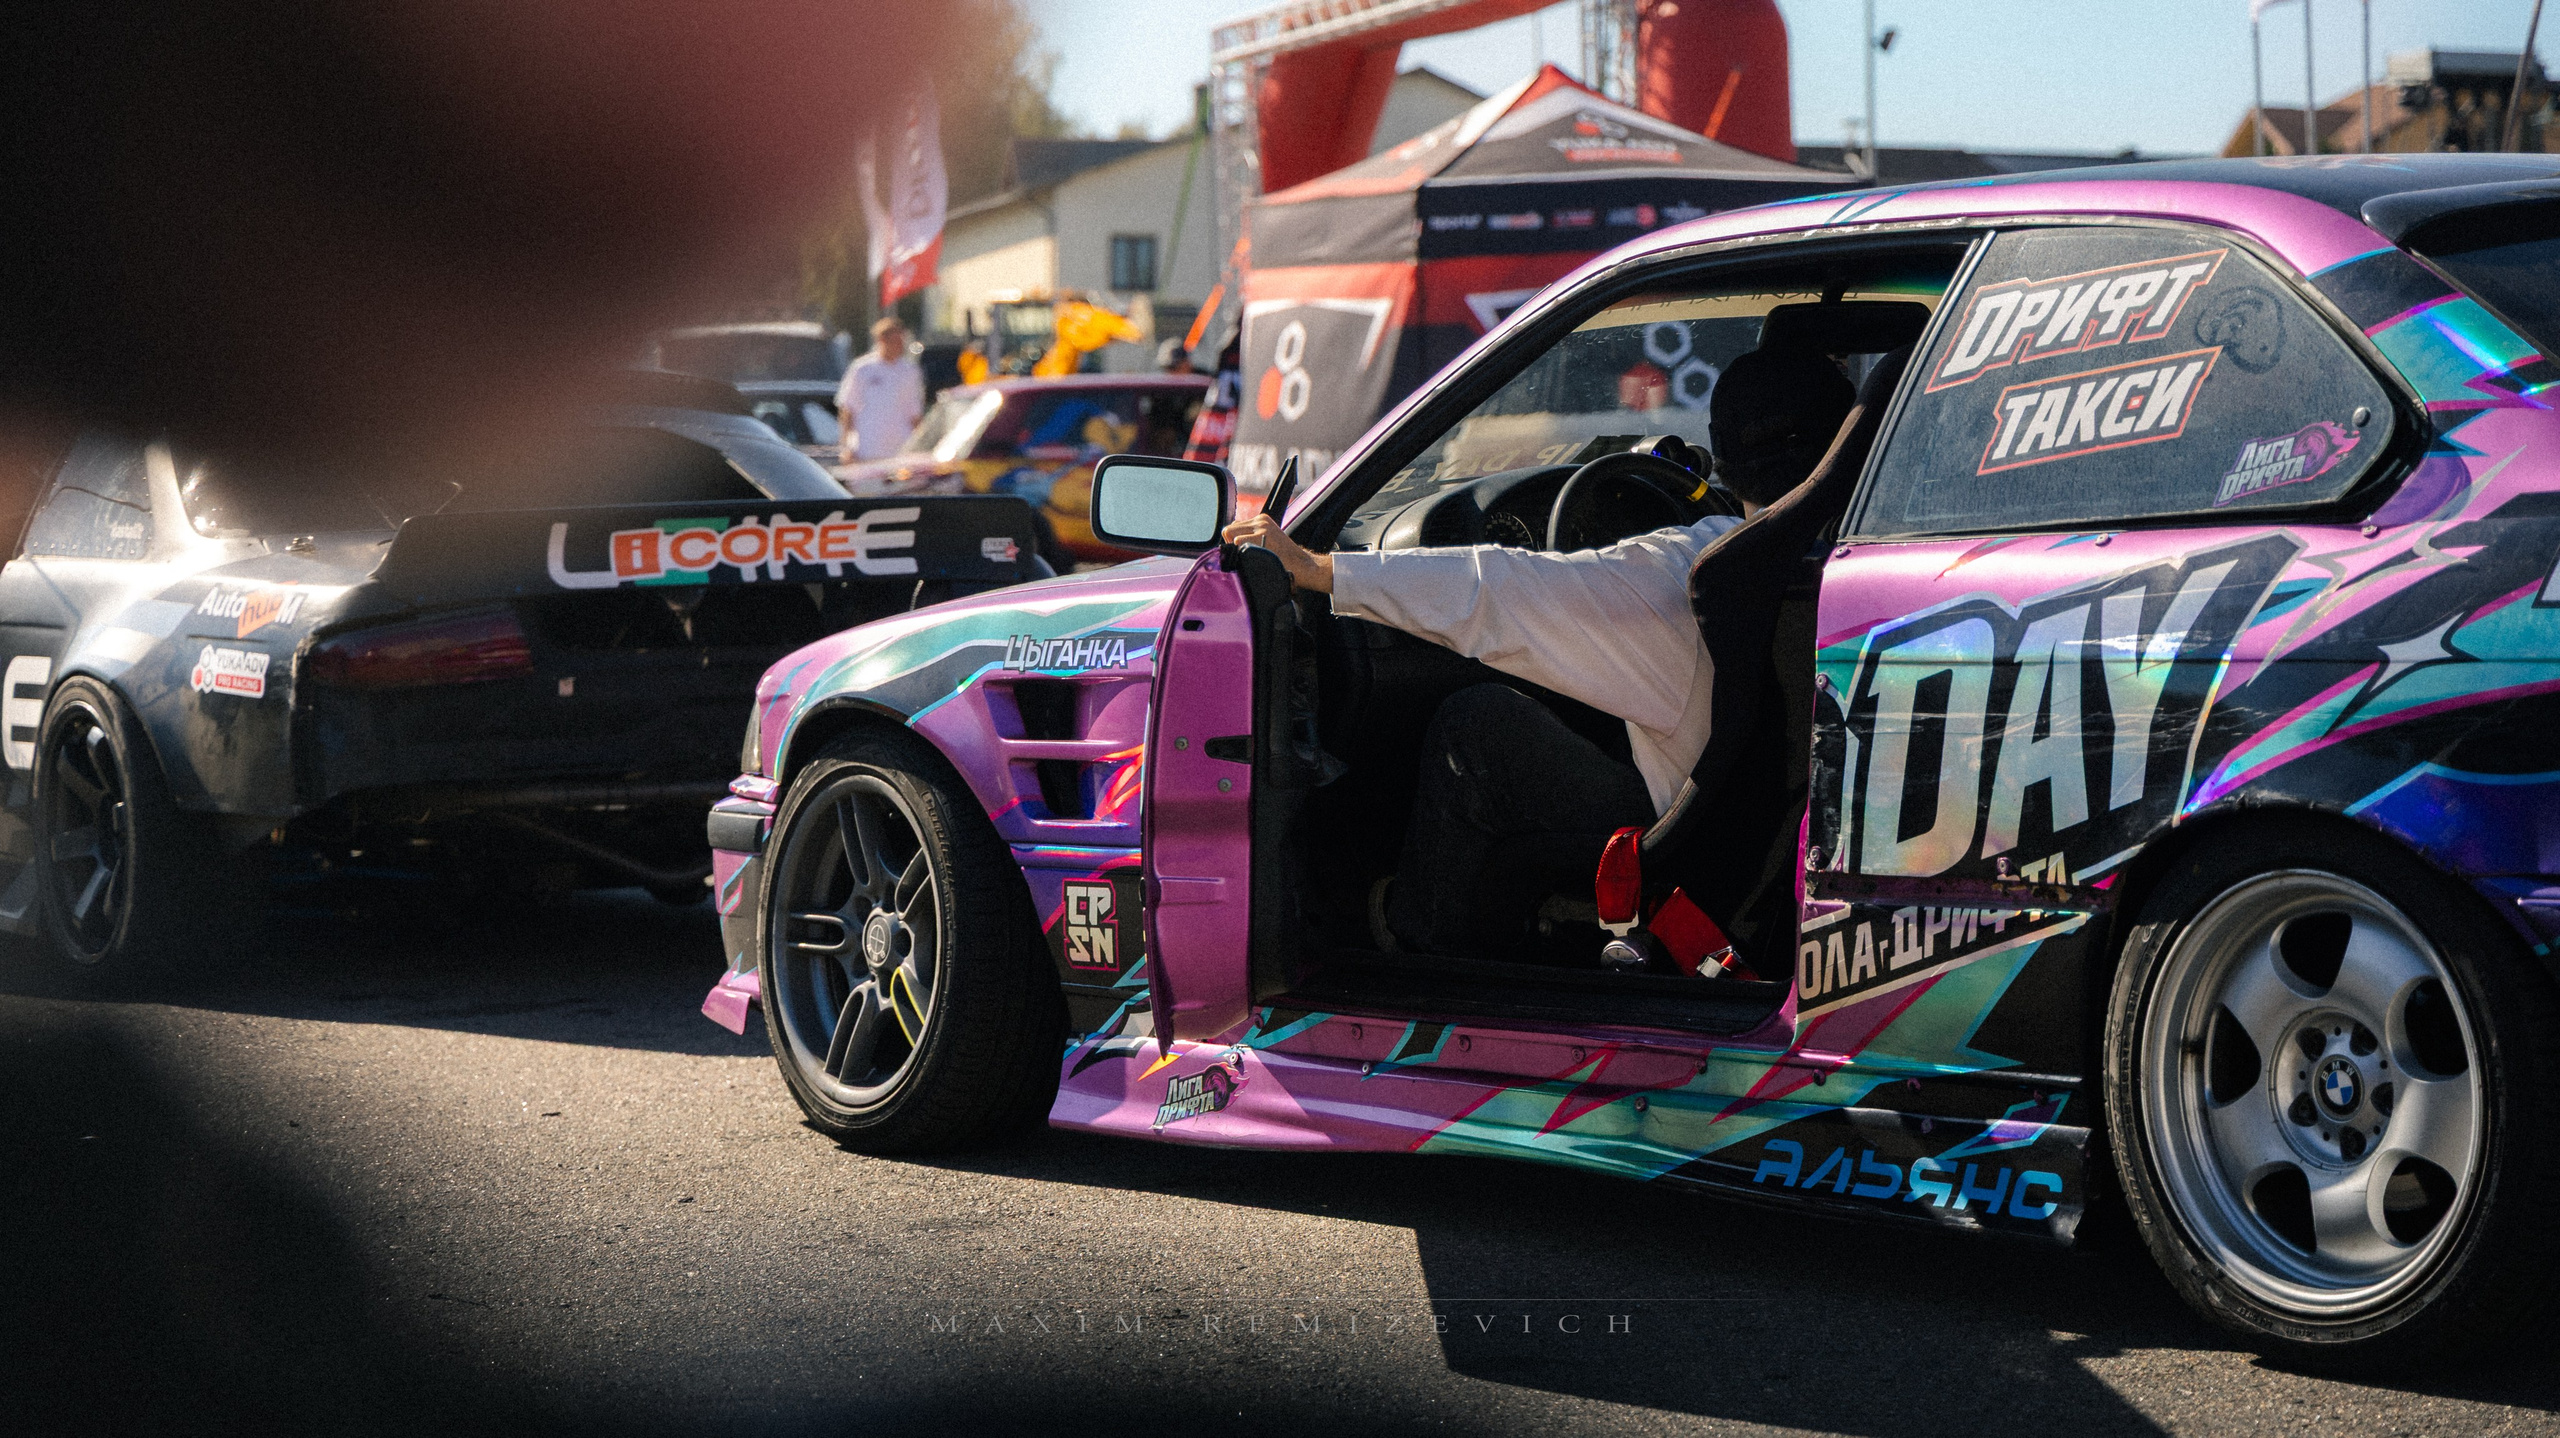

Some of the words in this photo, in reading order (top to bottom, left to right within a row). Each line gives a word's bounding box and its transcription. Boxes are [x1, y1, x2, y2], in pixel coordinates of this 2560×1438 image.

[1940, 262, 2210, 378] ДРИФТ
[1991, 361, 2205, 460] ТАКСИ
[2235, 437, 2296, 473] ЛИГА
[2218, 455, 2307, 502] ДРИФТА
[2321, 1061, 2355, 1081] BMW
[1166, 1075, 1203, 1105] ЛИГА
[1154, 1091, 1215, 1127] ДРИФТА
